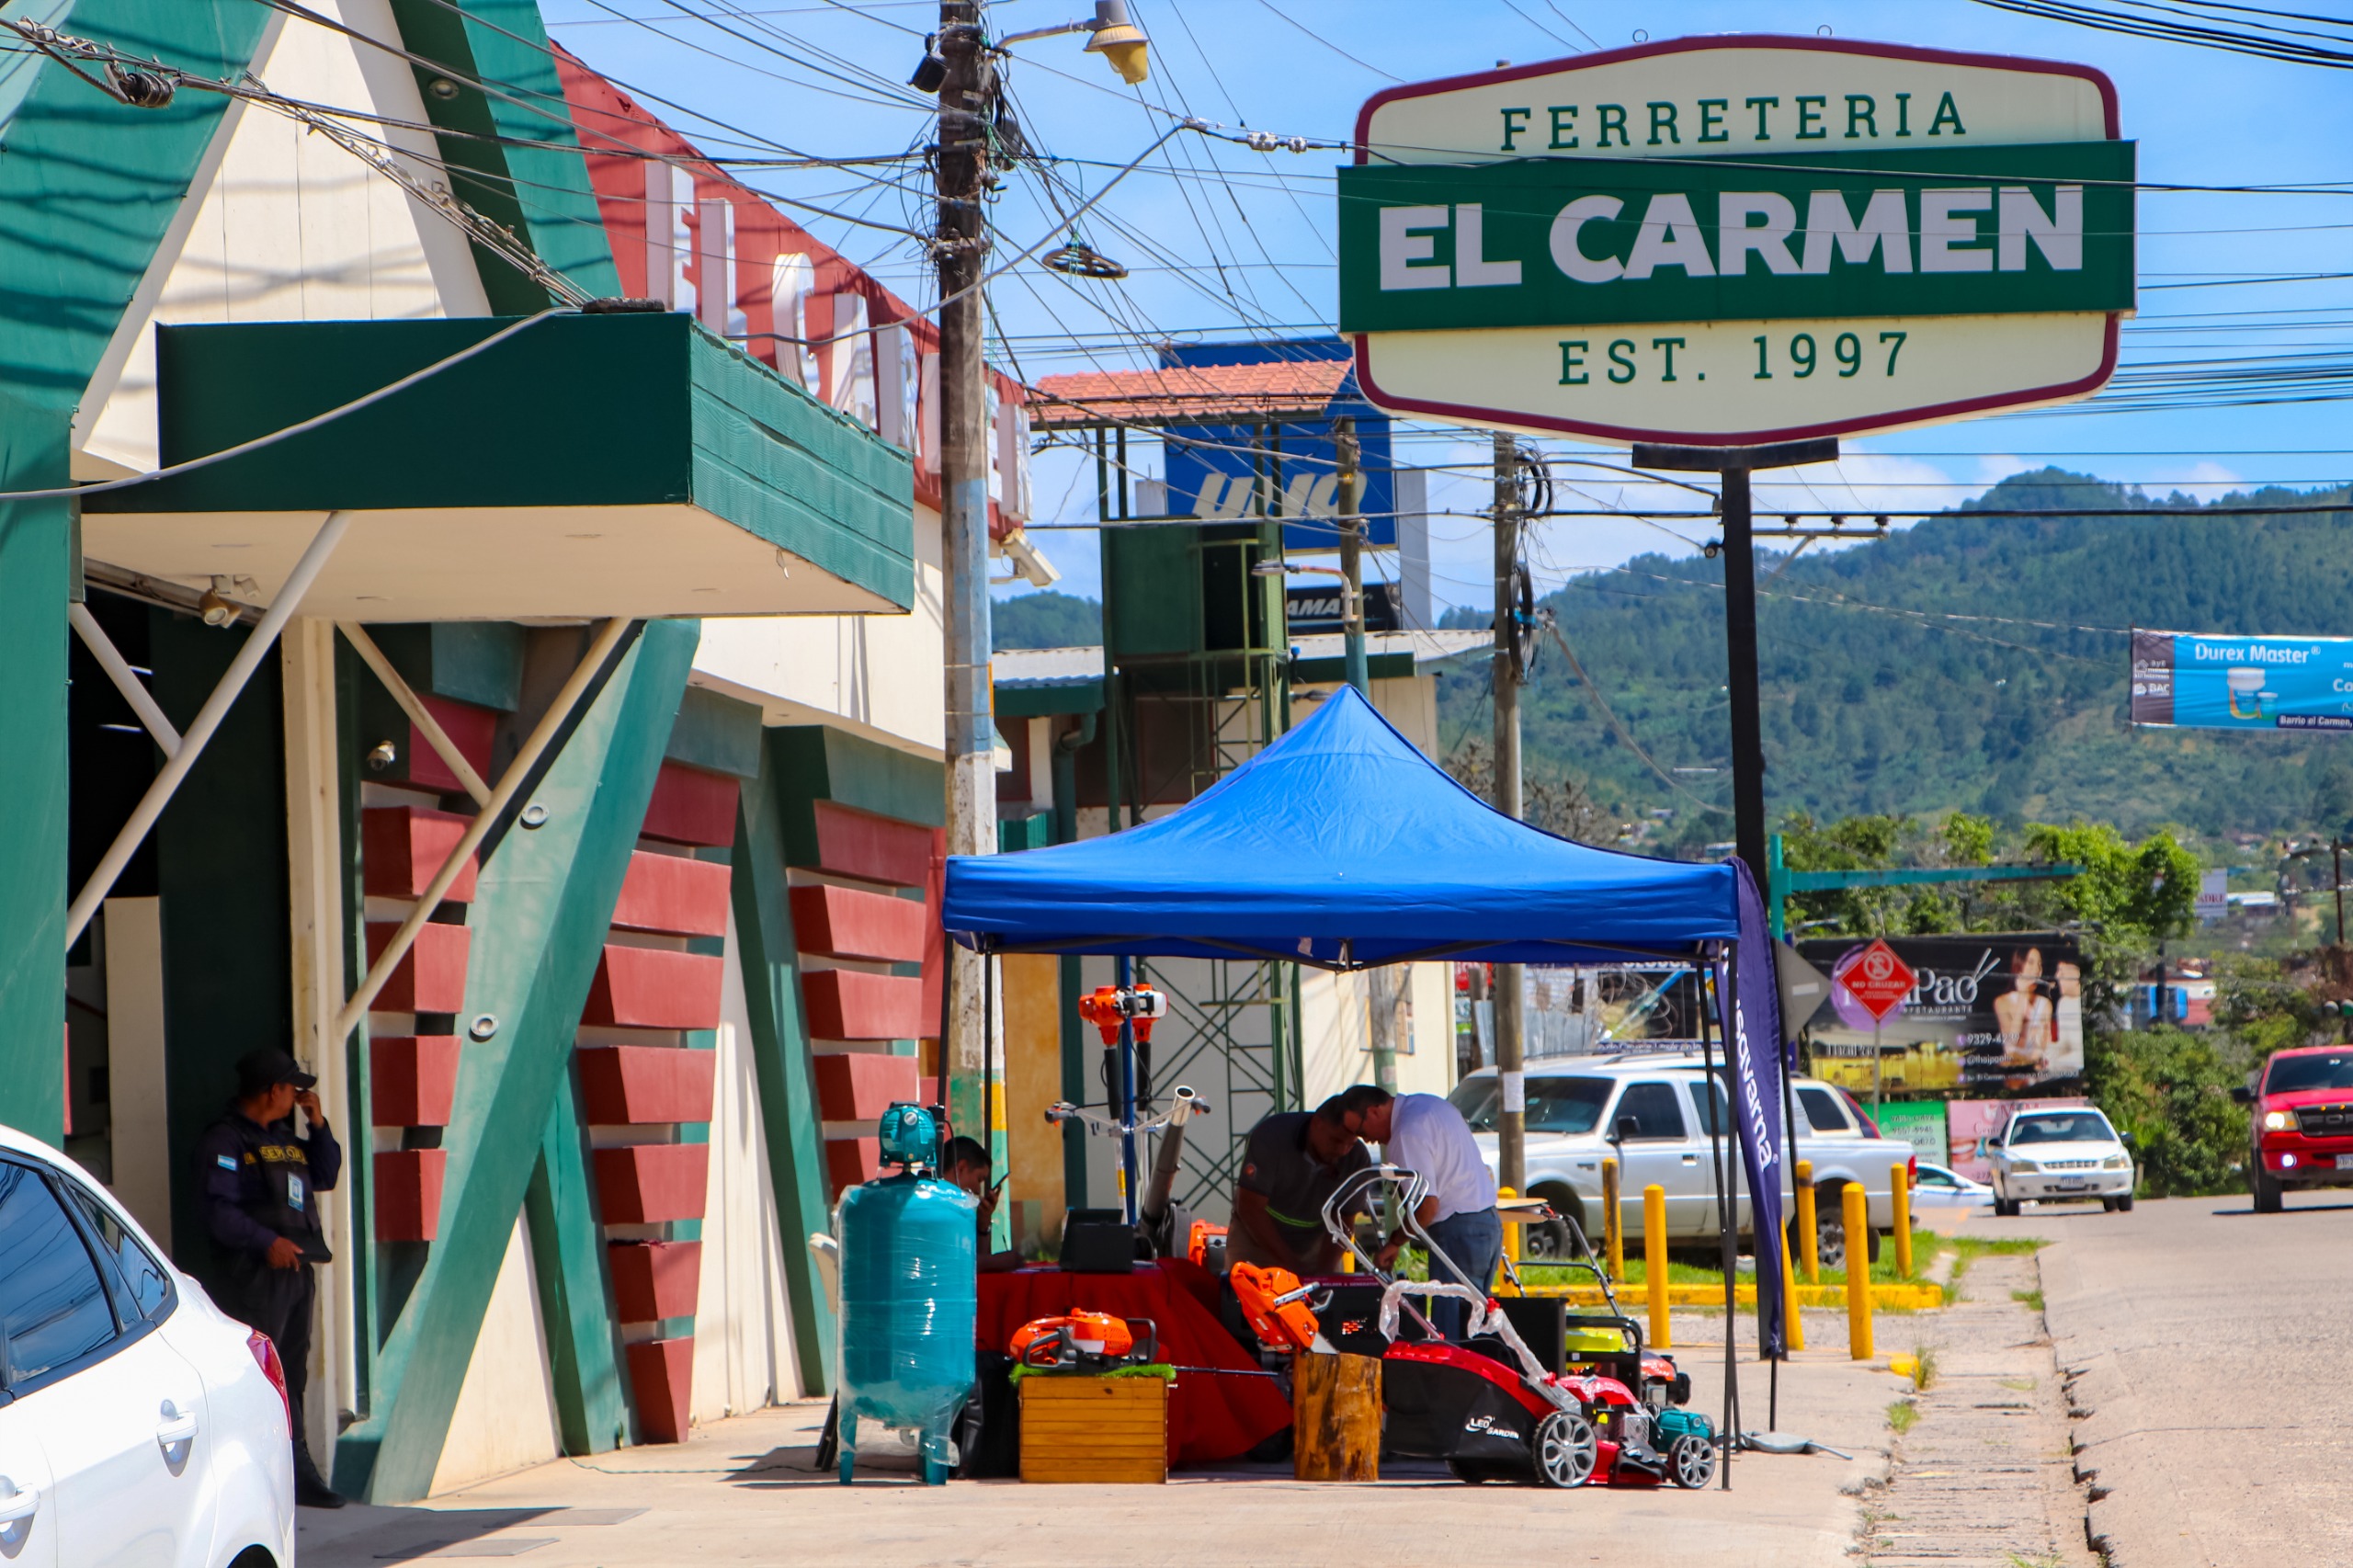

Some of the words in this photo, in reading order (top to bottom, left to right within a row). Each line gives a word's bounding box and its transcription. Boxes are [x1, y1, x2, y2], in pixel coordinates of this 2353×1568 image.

[1500, 91, 1967, 152] FERRETERIA
[1379, 202, 1522, 291] EL
[1549, 184, 2084, 284] CARMEN
[1557, 337, 1707, 385] EST.
[1753, 331, 1908, 380] 1997
[2195, 643, 2245, 662] Durex
[1471, 1417, 1491, 1429] LEO
[1486, 1426, 1520, 1440] GARDEN
